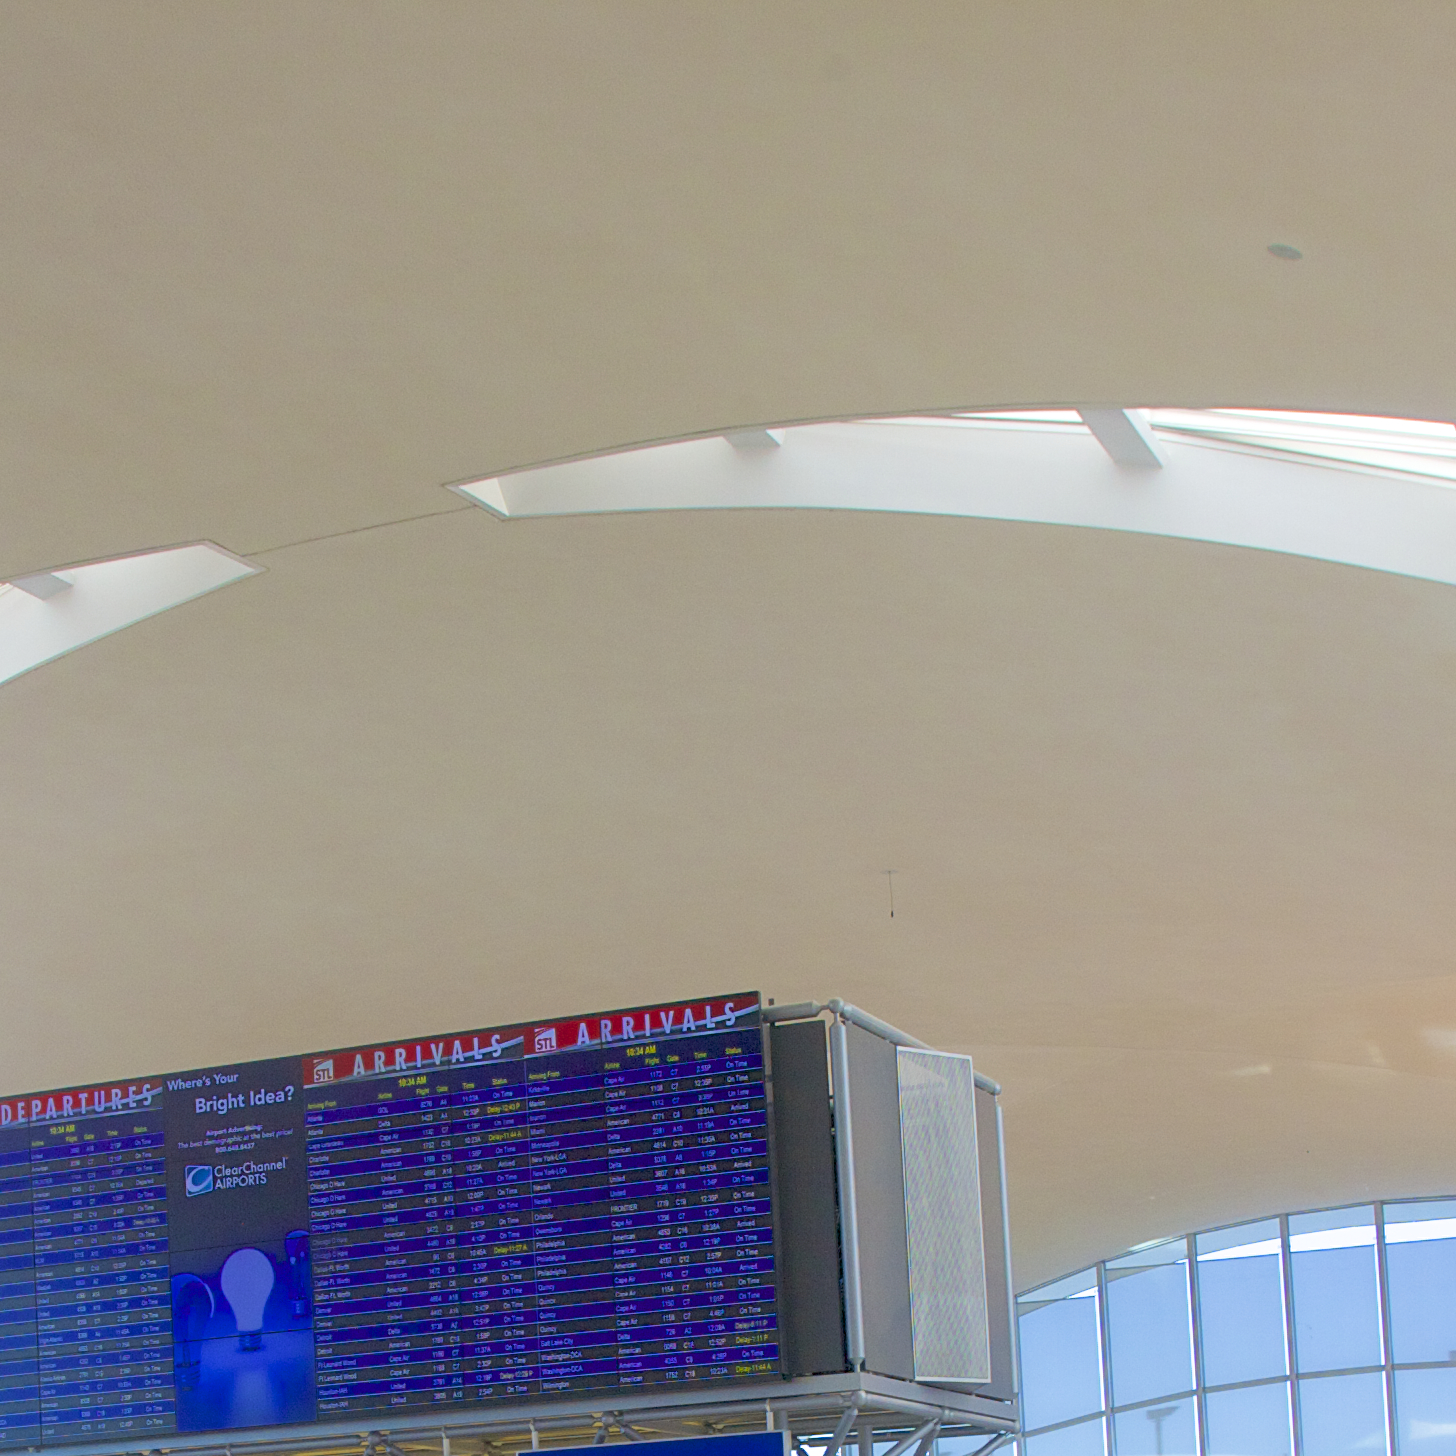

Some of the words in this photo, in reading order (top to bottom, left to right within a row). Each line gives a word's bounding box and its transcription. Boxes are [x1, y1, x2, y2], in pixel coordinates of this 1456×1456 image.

[537, 1038, 555, 1050] STL
[578, 1003, 736, 1046] ARRIVALS
[315, 1068, 332, 1081] STL
[353, 1034, 502, 1076] ARRIVALS
[645, 1045, 656, 1054] AM
[167, 1076, 210, 1091] Where's
[214, 1073, 239, 1085] Your
[416, 1076, 426, 1085] AM
[1, 1084, 151, 1125] DEPARTURES
[196, 1093, 244, 1114] Bright
[250, 1086, 294, 1106] Idea?
[215, 1174, 266, 1189] AIRPORTS
